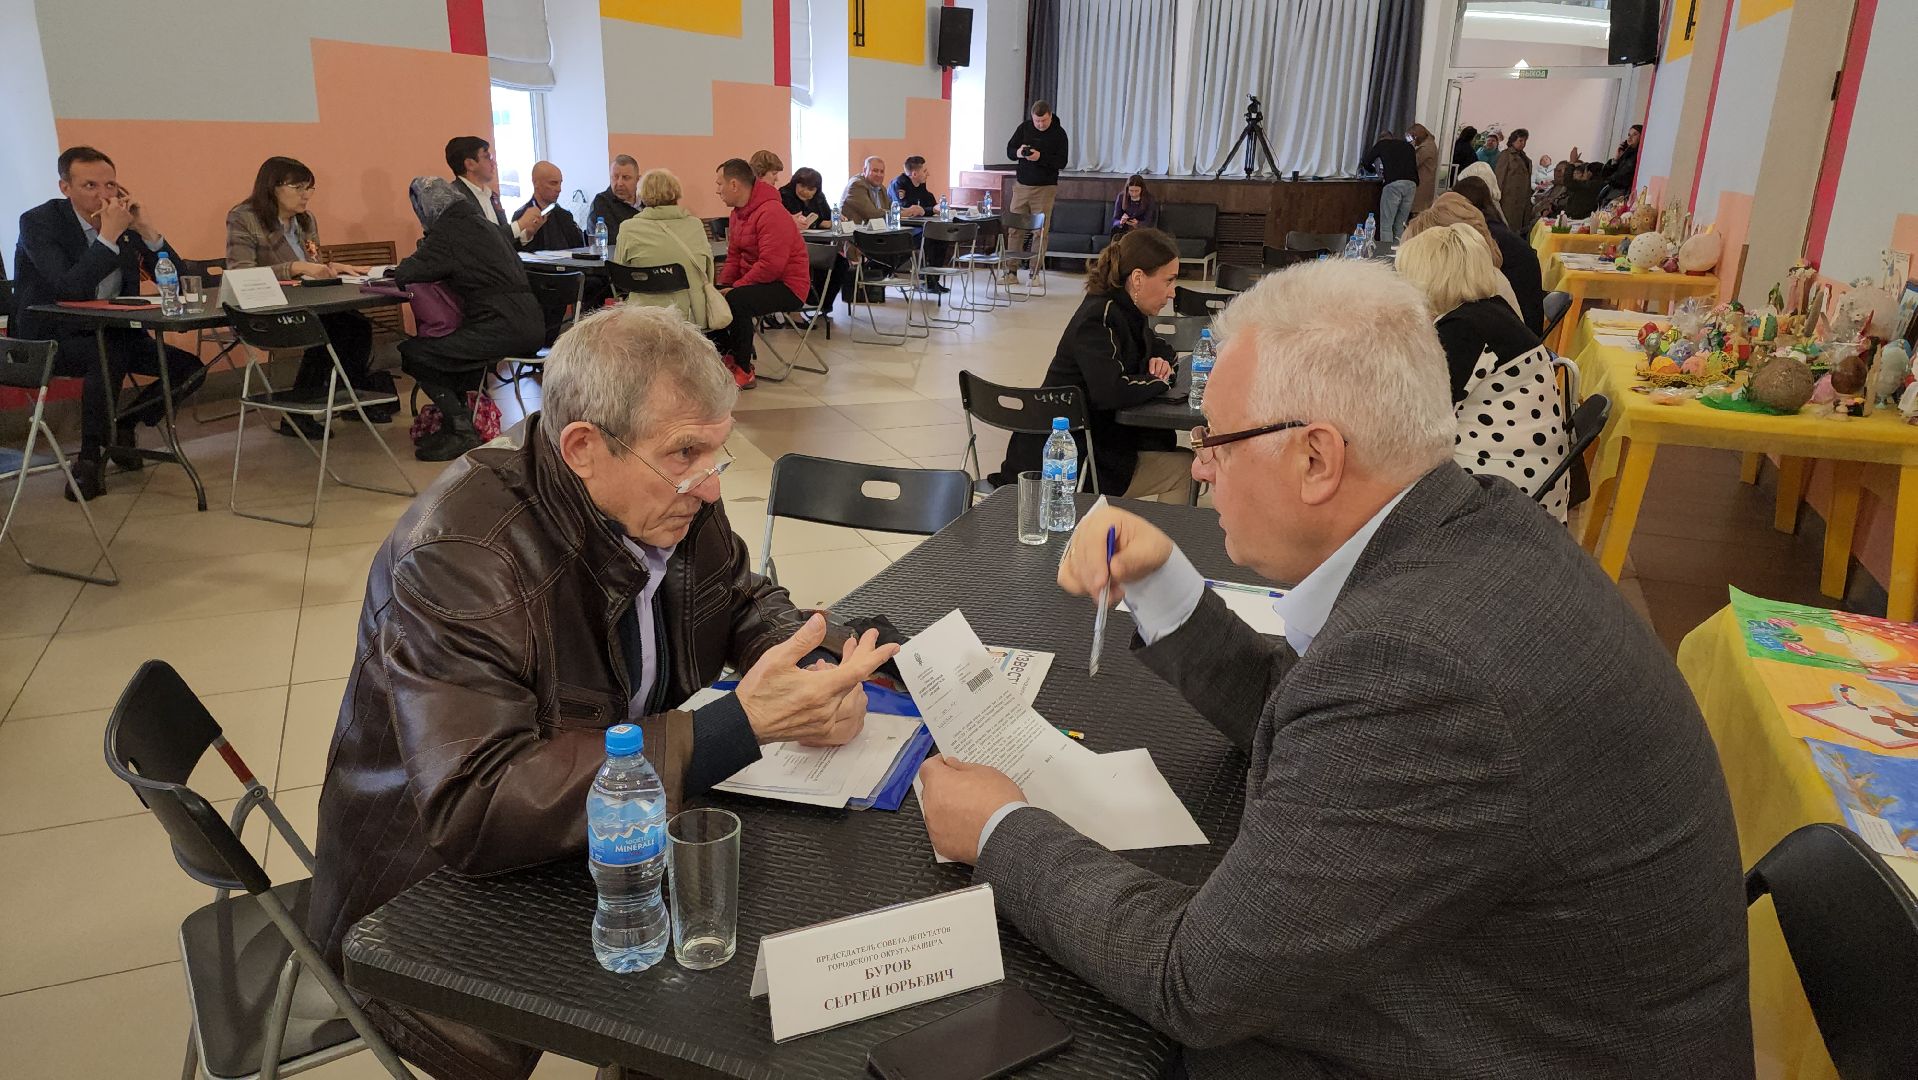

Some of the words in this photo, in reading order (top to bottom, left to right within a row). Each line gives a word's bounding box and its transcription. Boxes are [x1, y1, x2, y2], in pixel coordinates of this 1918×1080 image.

[816, 944, 876, 964] ПРЕДСЕДАТЕЛЬ
[876, 936, 908, 949] СОВЕТА
[908, 926, 951, 942] ДЕПУТАТОВ
[828, 954, 879, 972] ГОРОДСКОГО
[880, 947, 910, 959] ОКРУГА
[865, 959, 912, 981] БУРОВ
[824, 985, 881, 1011] СЕРГЕЙ
[885, 968, 954, 996] ЮРЬЕВИЧ
